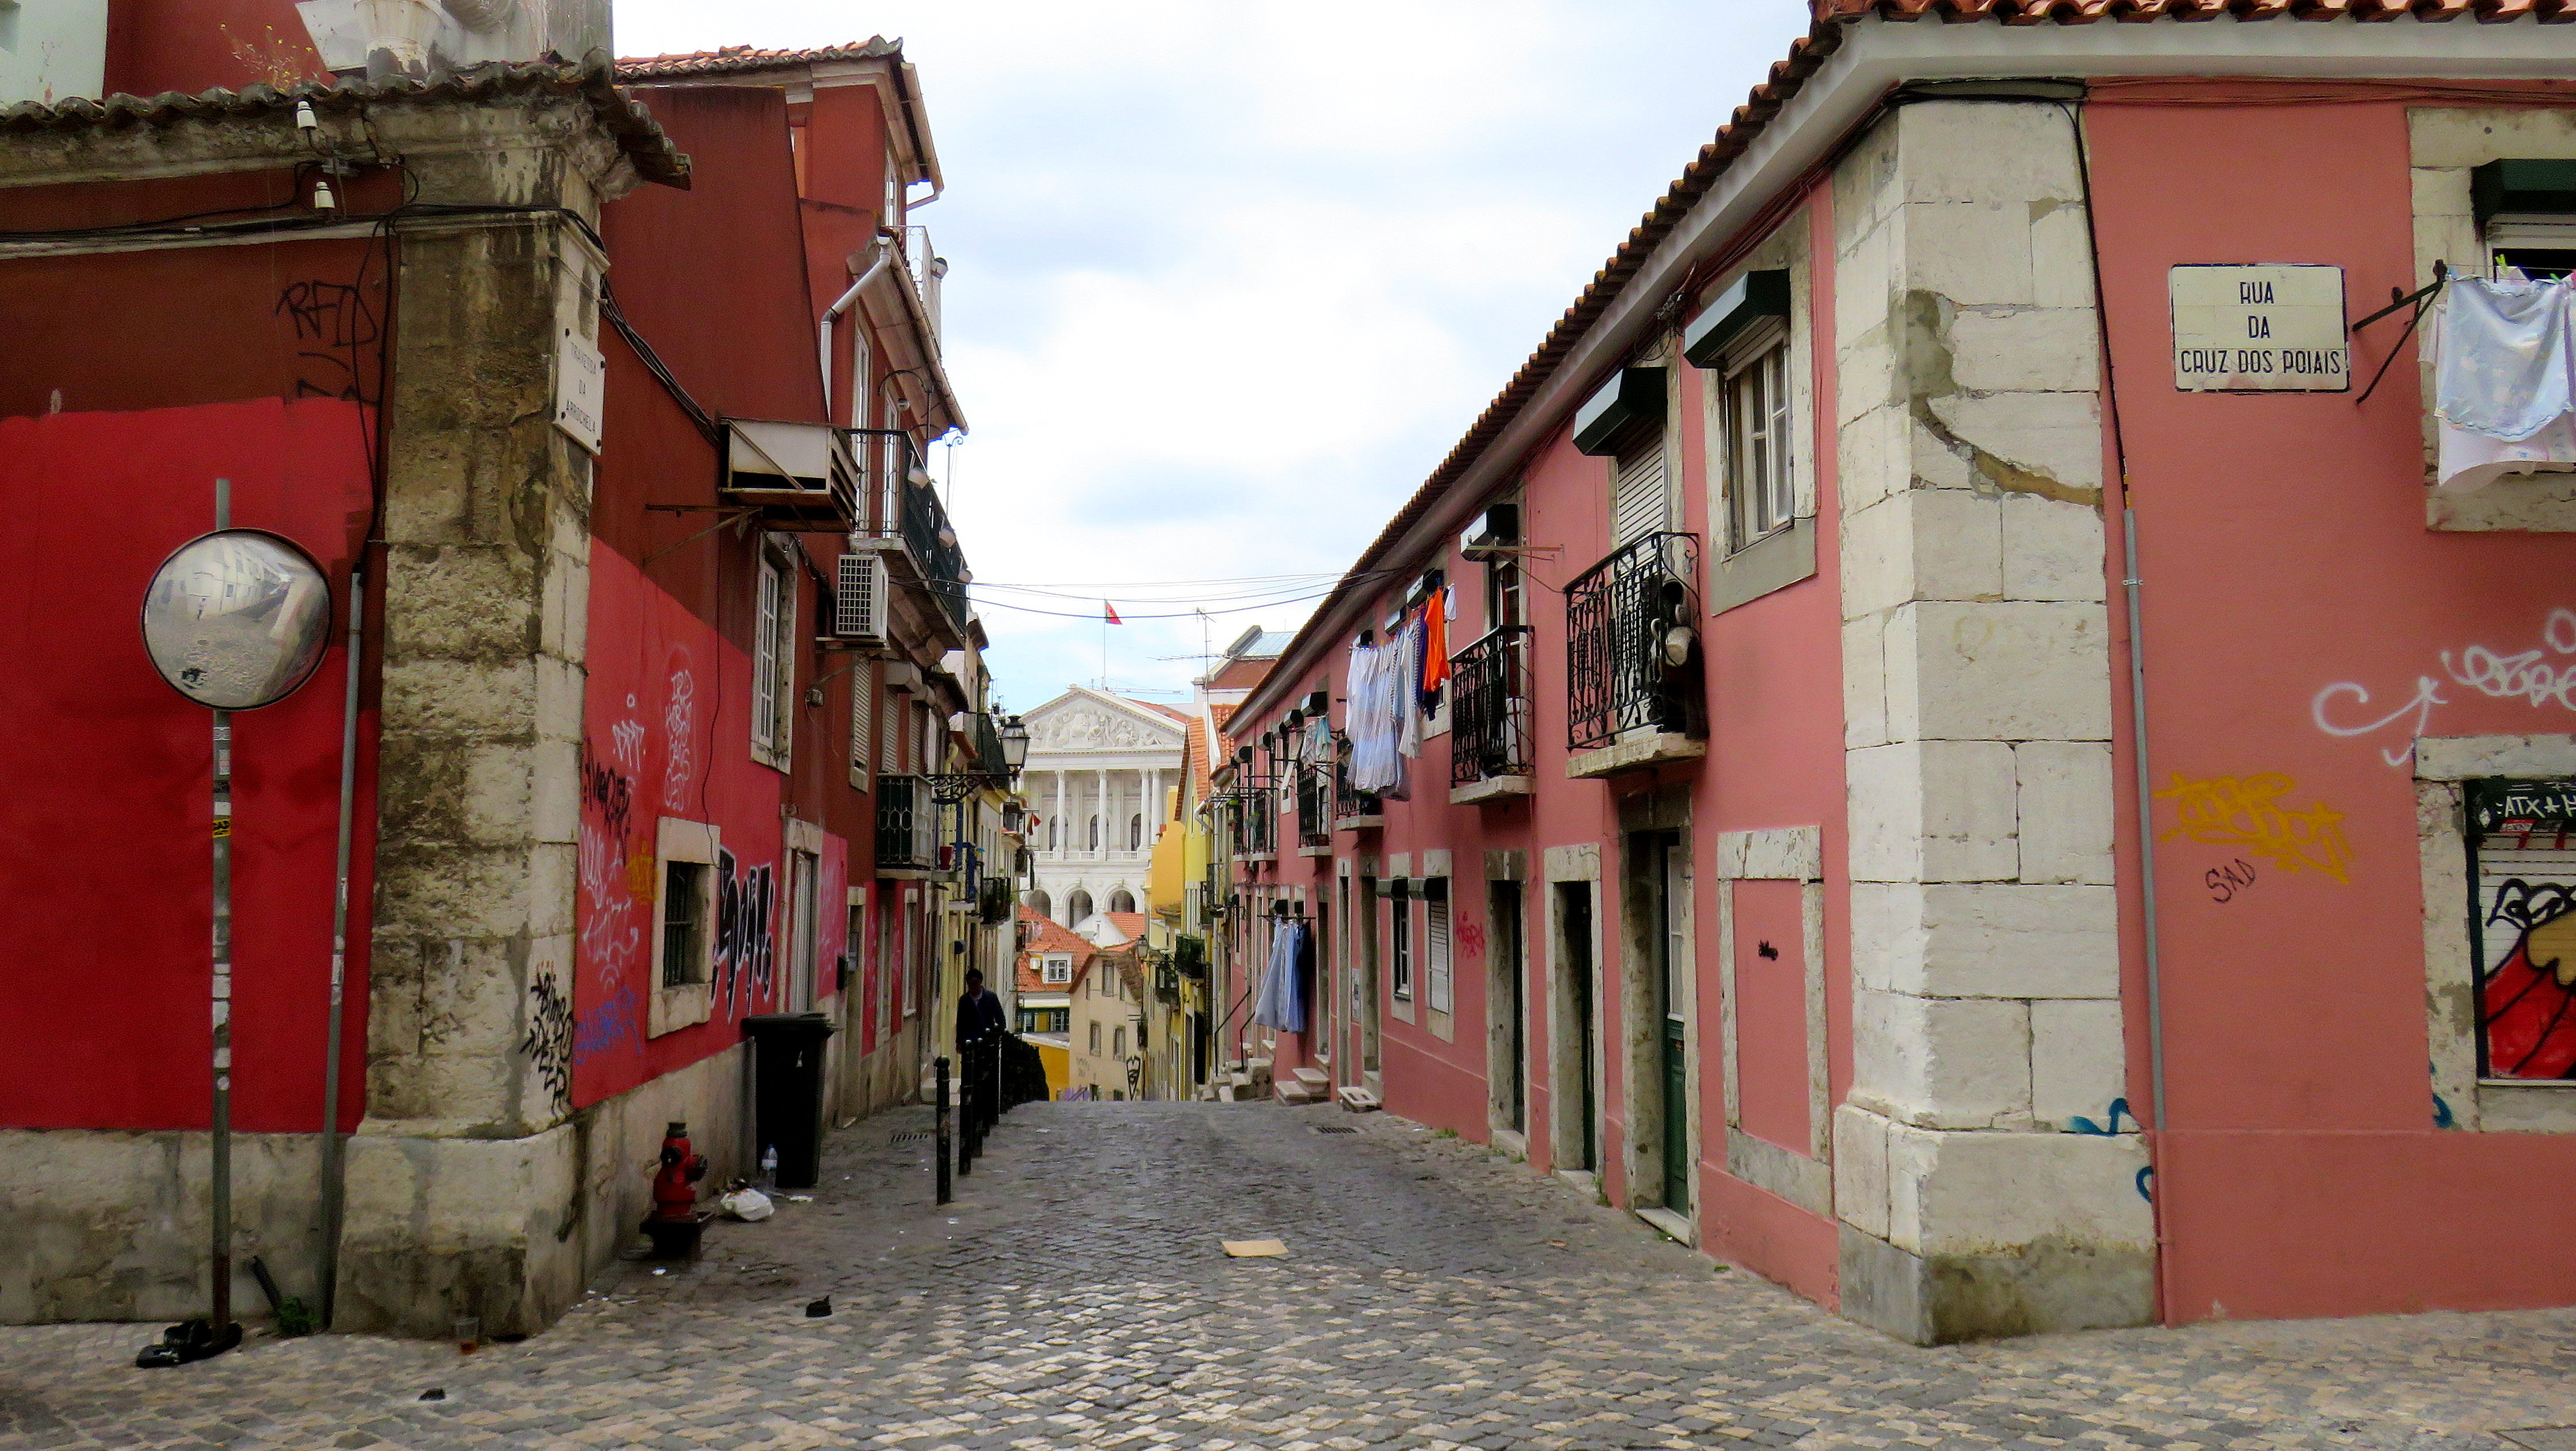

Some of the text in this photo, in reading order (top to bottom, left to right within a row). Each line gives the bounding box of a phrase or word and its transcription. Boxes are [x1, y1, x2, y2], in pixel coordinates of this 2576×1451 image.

[2239, 281, 2274, 304] RUA
[2247, 315, 2270, 339] DA
[2180, 350, 2340, 374] CRUZ DOS POIAIS
